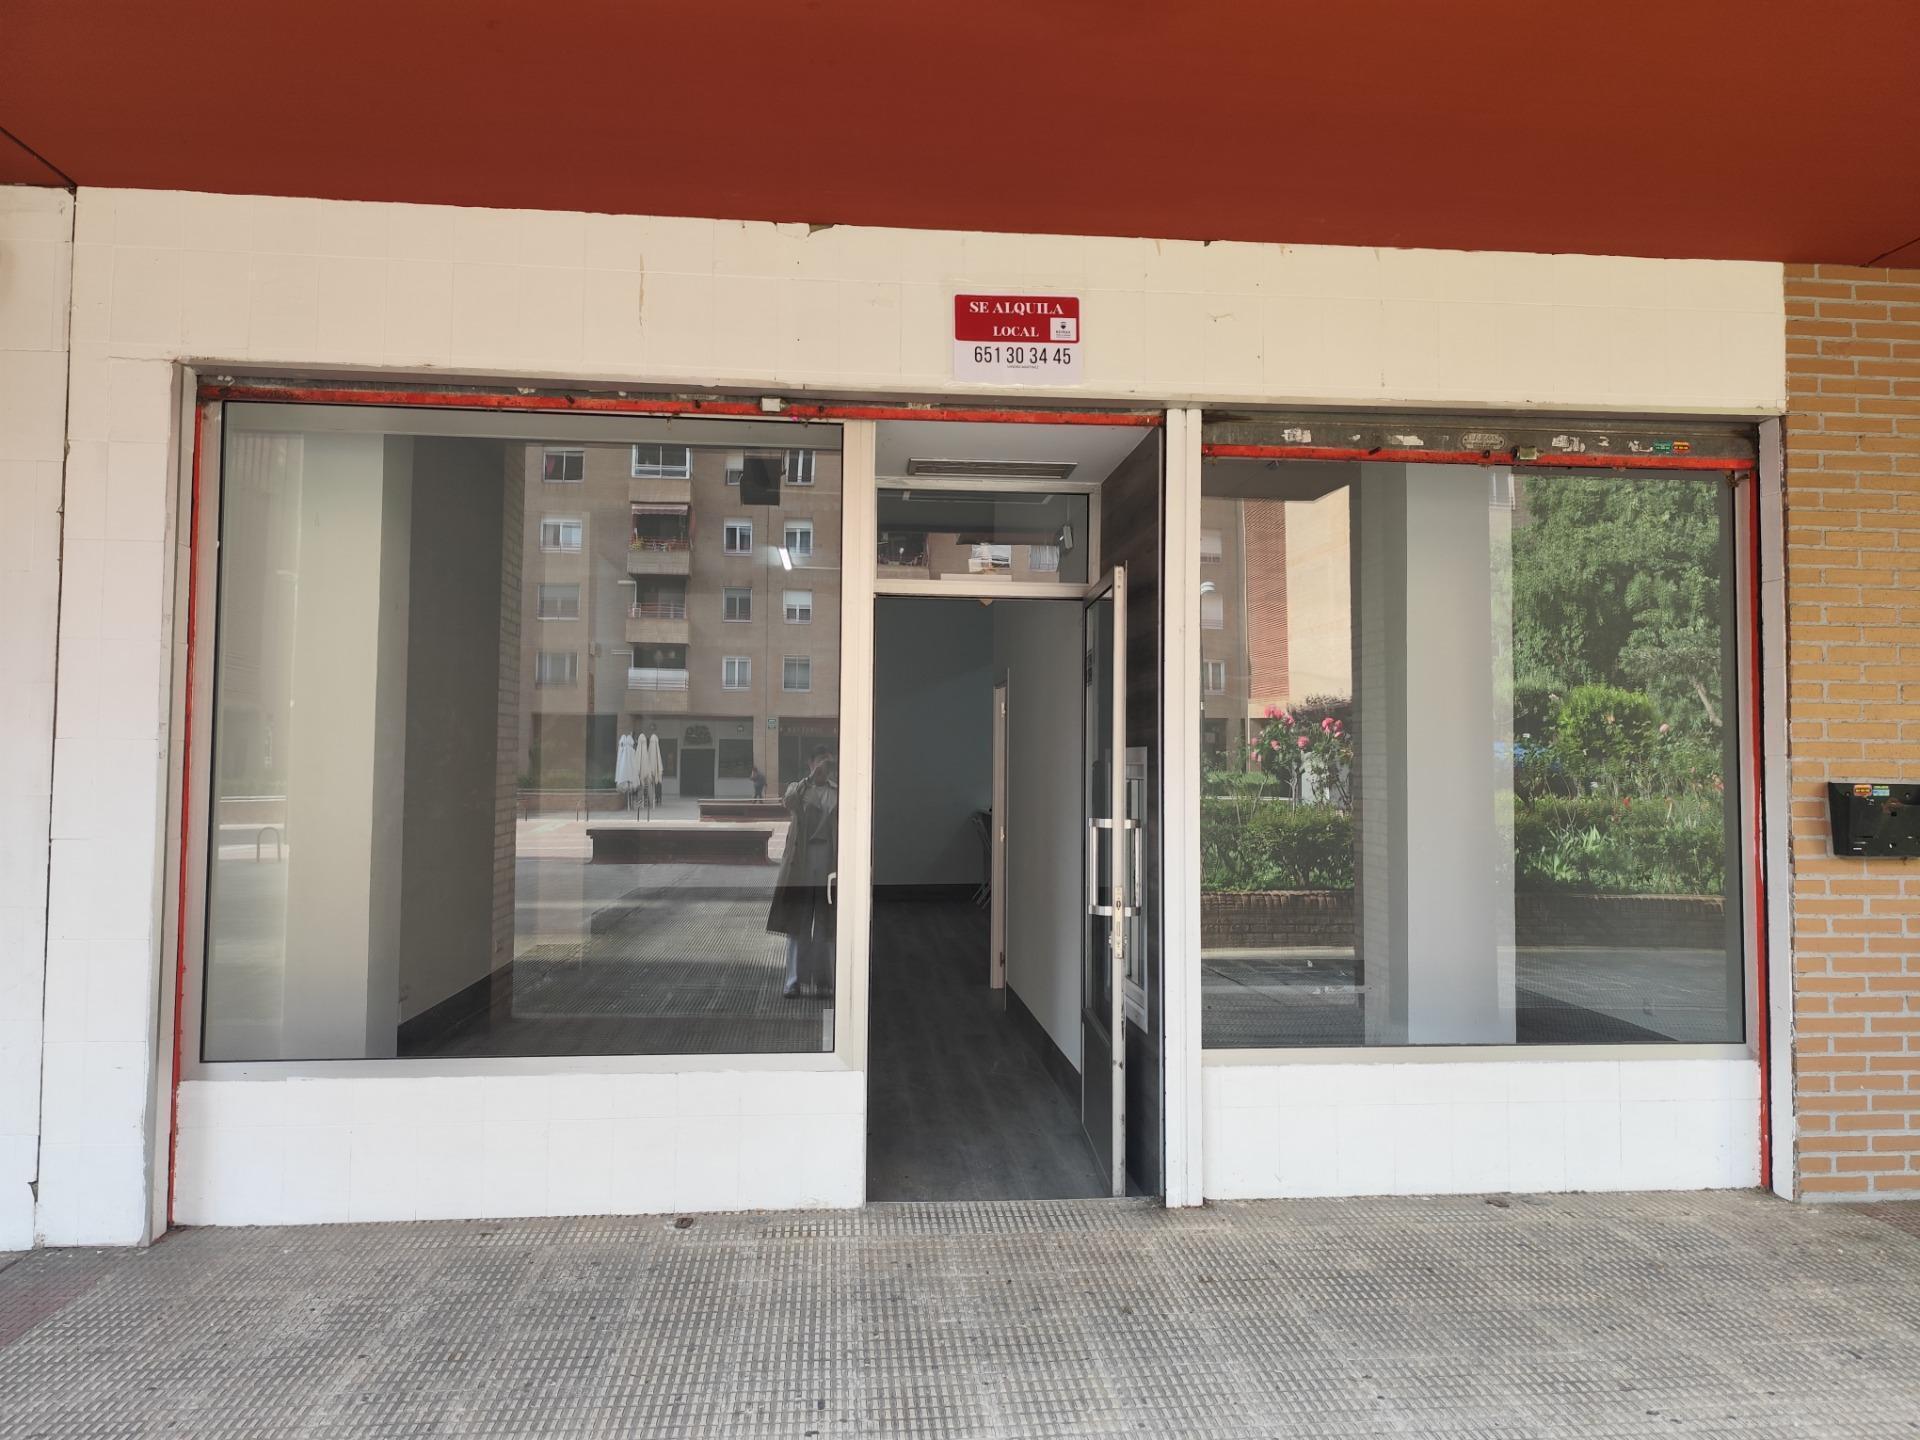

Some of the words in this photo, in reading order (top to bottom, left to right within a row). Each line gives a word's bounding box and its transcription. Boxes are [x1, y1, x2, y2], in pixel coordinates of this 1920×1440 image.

[969, 301, 989, 314] SE
[992, 302, 1064, 316] ALQUILA
[992, 326, 1040, 337] LOCAL
[974, 345, 1001, 364] 651
[1006, 346, 1024, 364] 30
[1029, 347, 1047, 364] 34
[1052, 347, 1071, 365] 45
